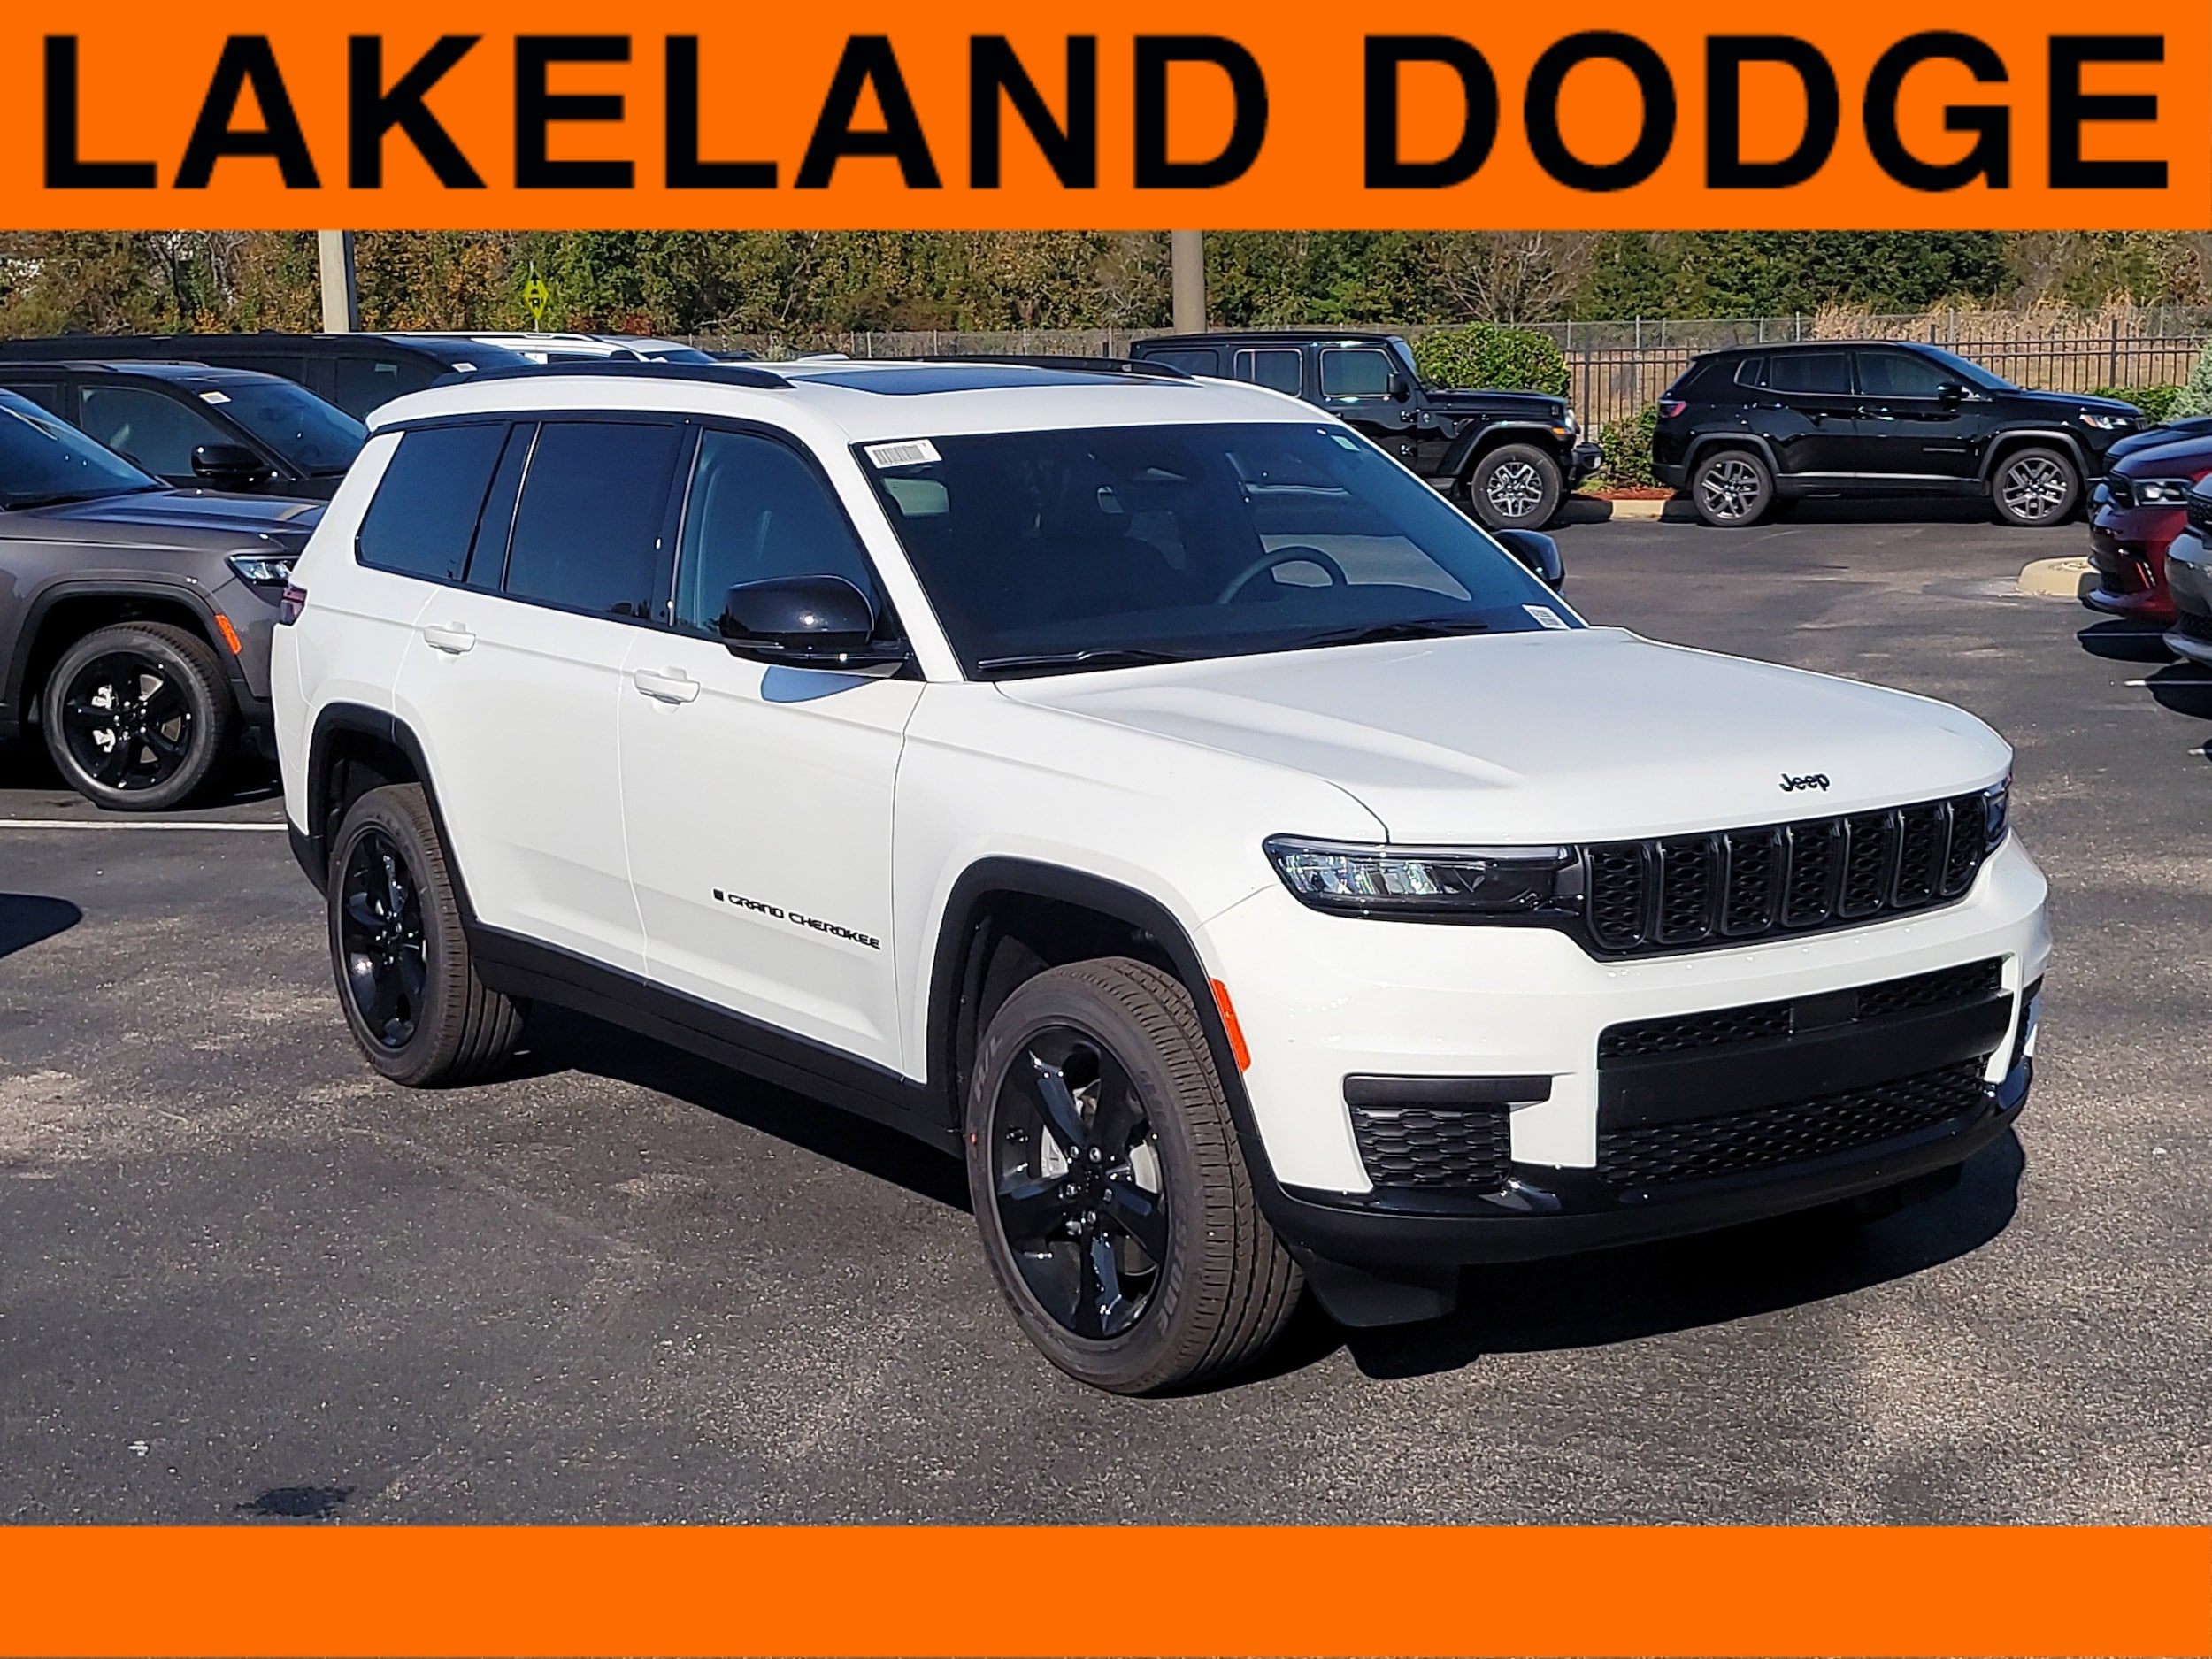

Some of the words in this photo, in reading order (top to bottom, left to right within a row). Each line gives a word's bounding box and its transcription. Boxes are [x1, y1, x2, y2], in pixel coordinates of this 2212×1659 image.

[1779, 773, 1830, 792] Jeep
[728, 894, 785, 918] GRAND
[788, 912, 881, 949] CHEROKEE
